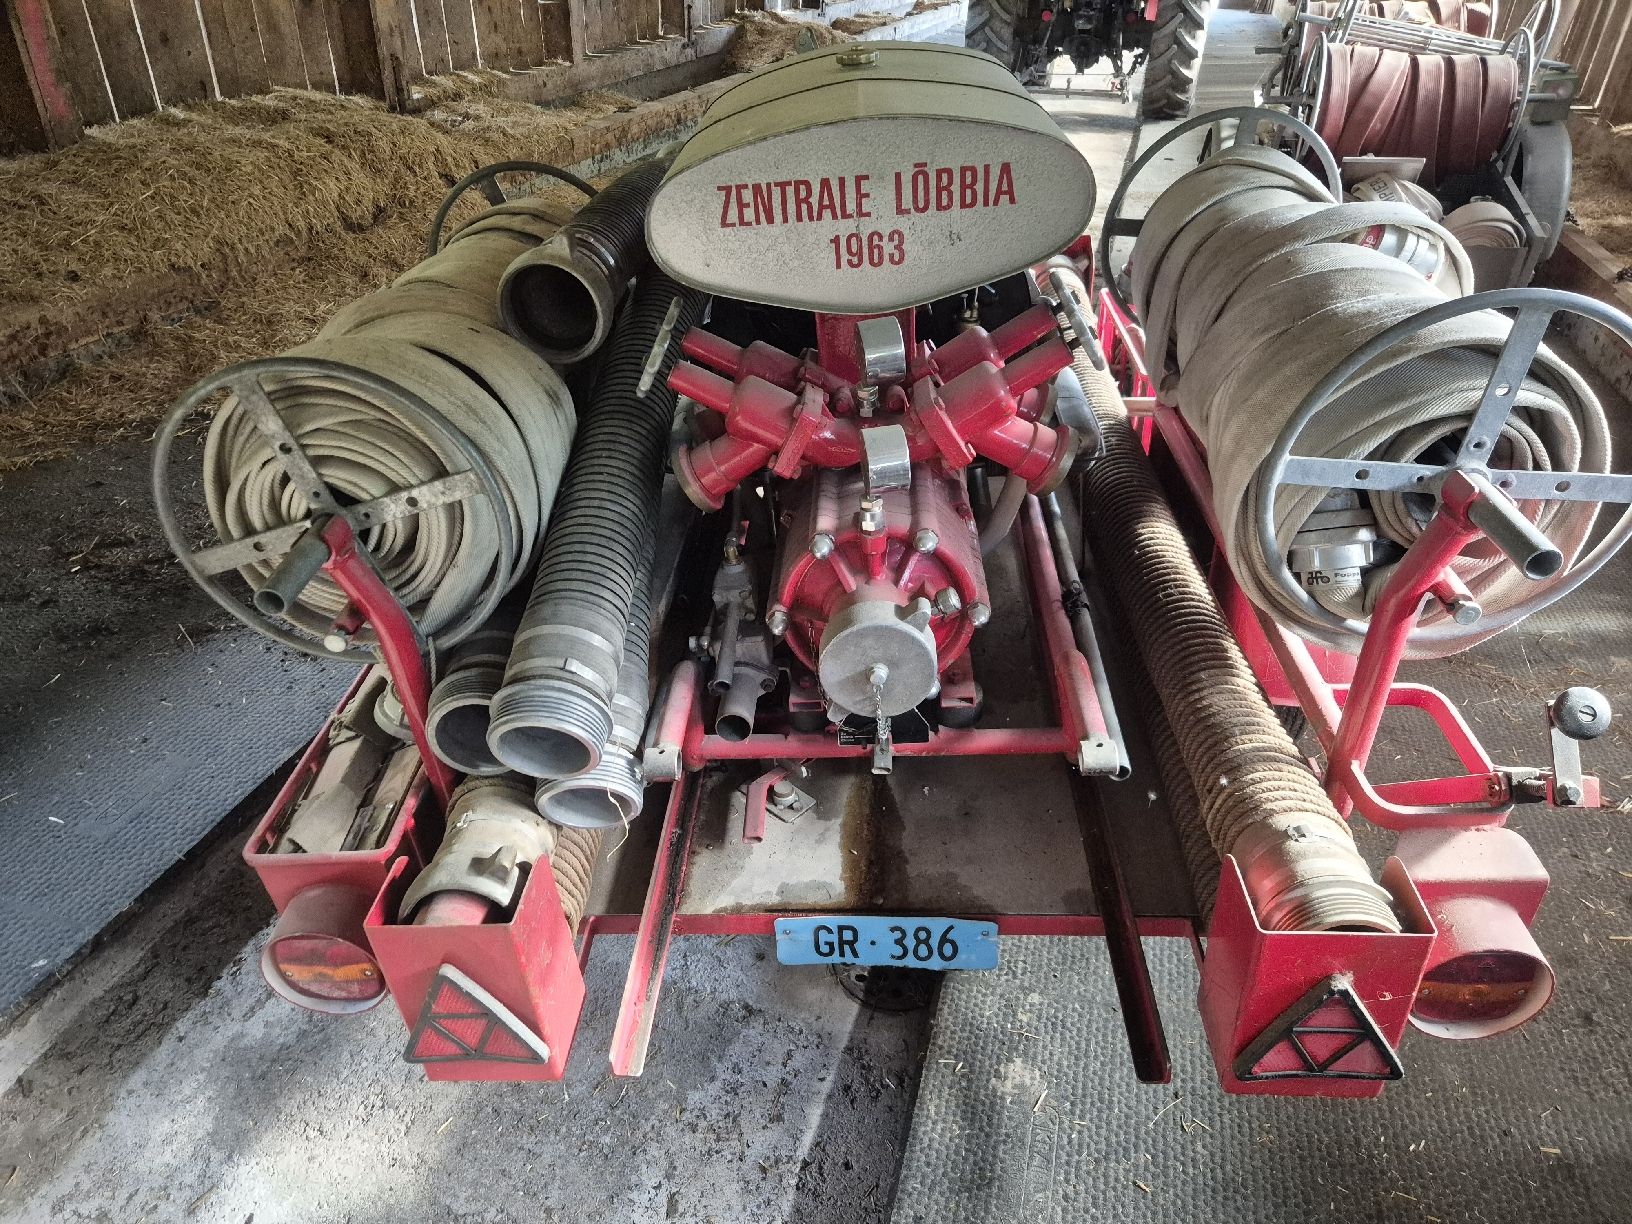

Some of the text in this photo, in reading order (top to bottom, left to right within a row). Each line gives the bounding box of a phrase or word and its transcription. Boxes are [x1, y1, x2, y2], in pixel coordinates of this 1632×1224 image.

[716, 174, 872, 228] ZENTRALE
[829, 229, 906, 270] 1963
[813, 924, 860, 958] GR
[889, 924, 959, 962] 386
